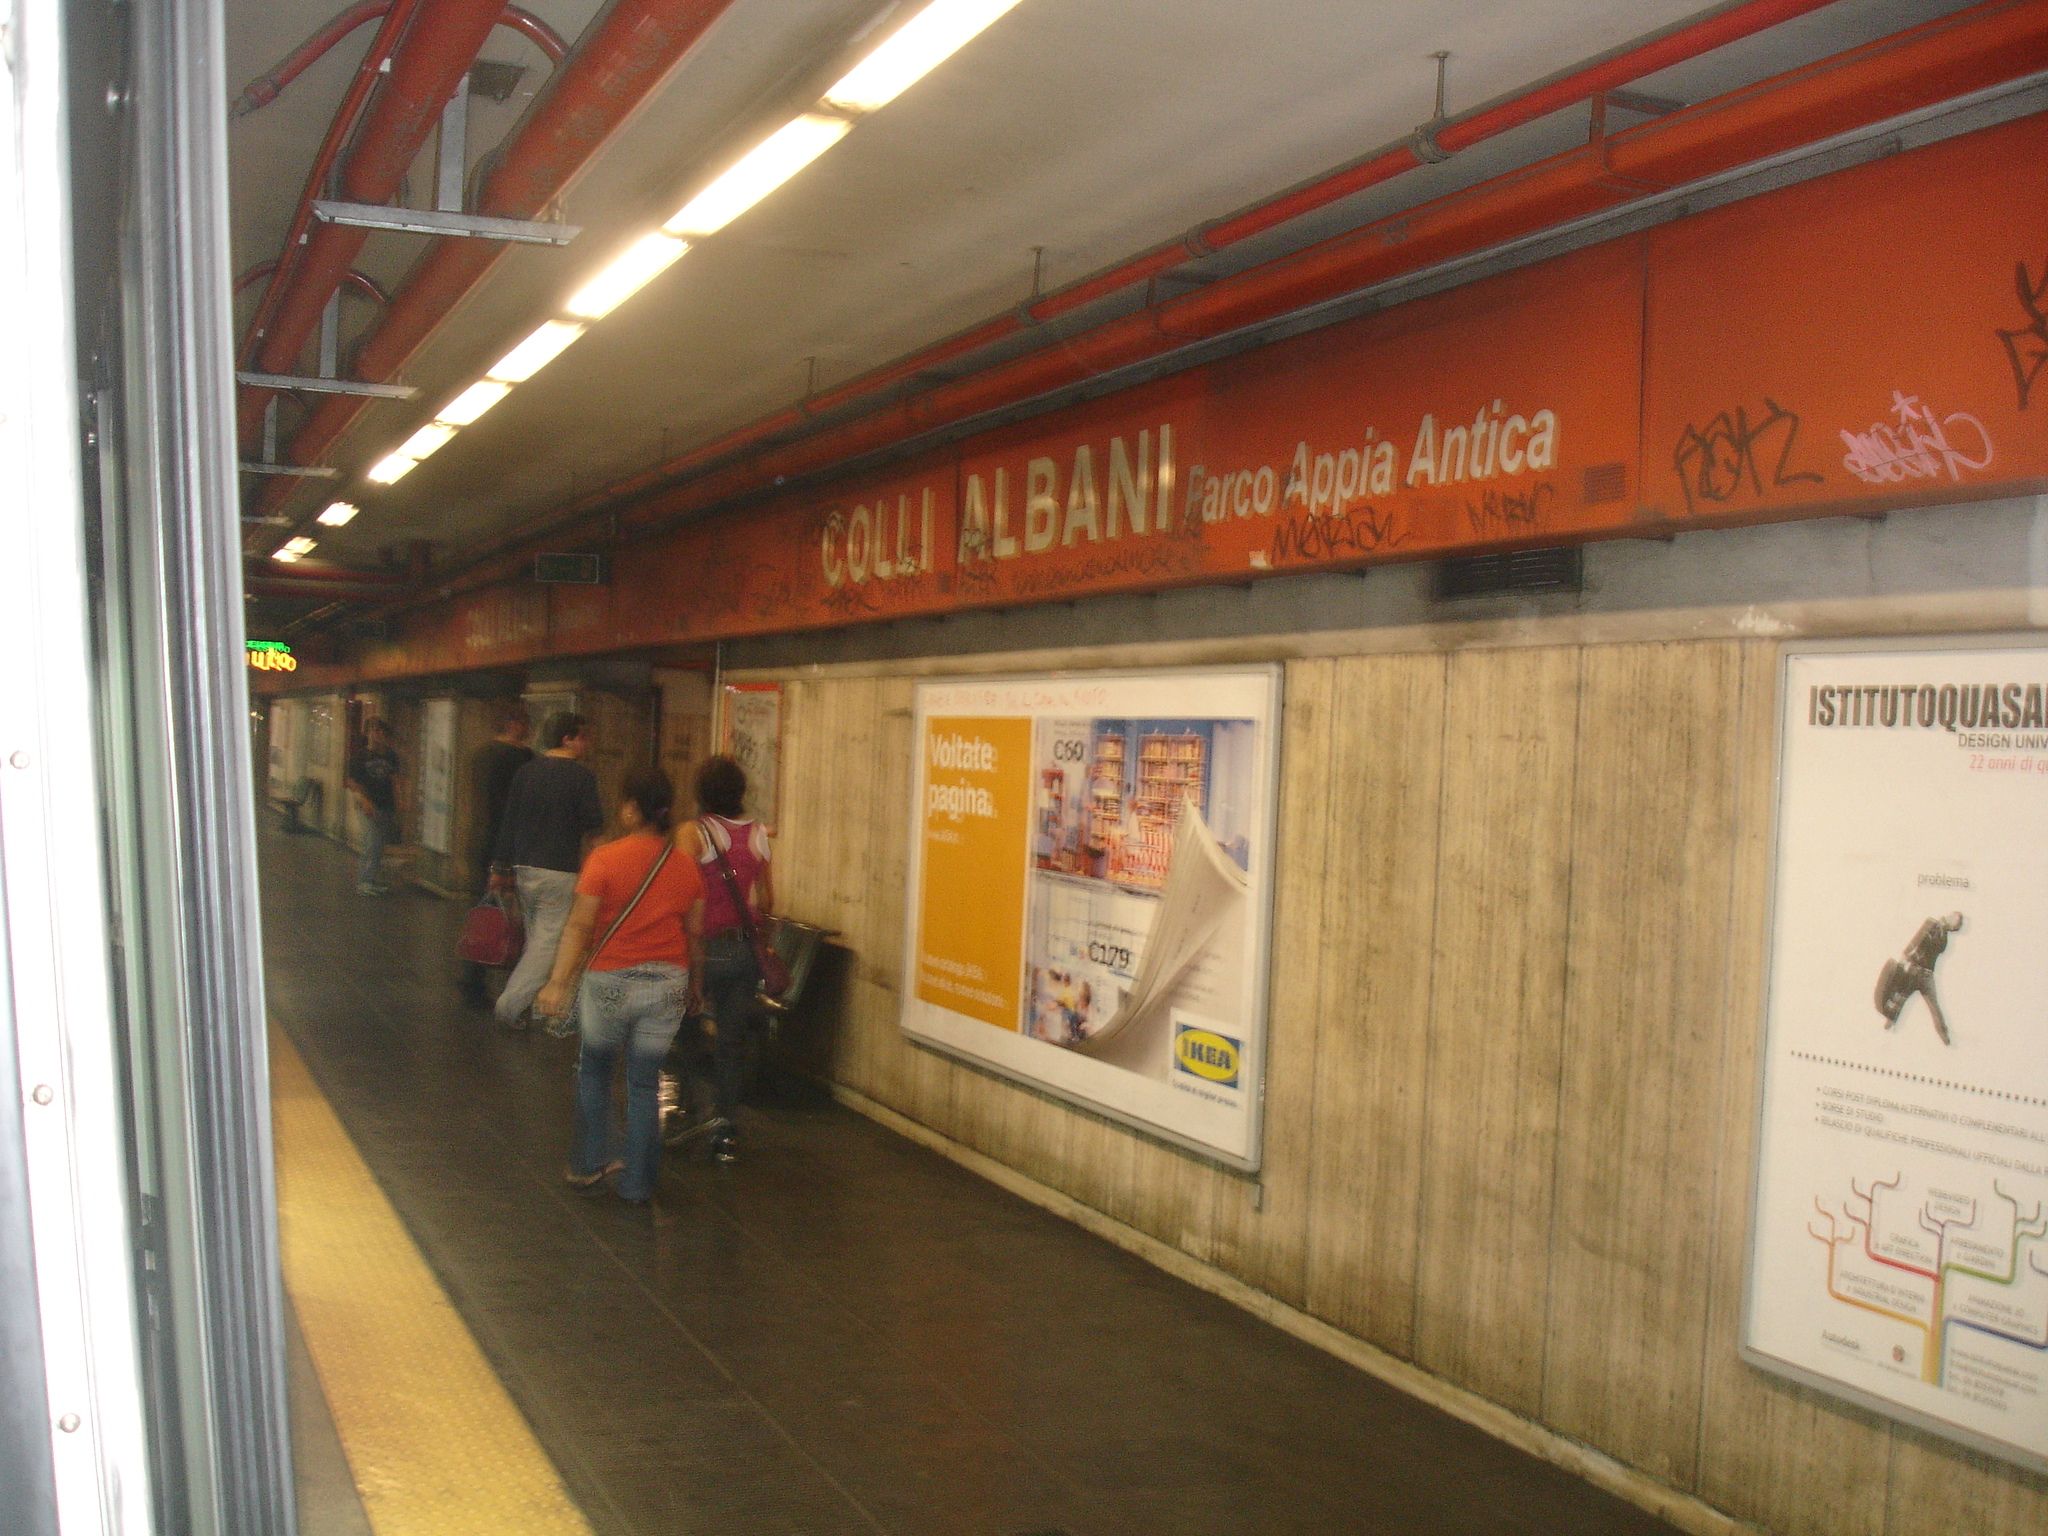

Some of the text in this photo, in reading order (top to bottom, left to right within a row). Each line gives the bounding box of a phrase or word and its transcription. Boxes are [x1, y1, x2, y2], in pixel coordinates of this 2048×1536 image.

[1284, 426, 1397, 521] Appia
[1406, 399, 1558, 486] Antica
[822, 487, 933, 587] COLLI
[957, 423, 1174, 564] ALBANI
[1808, 683, 2048, 732] ISTITUTOQUASA
[930, 733, 996, 772] Voltate
[1957, 733, 2011, 749] DESIGN
[1969, 753, 1985, 770] 22
[1987, 755, 2016, 770] anni
[2020, 754, 2033, 771] di
[1917, 872, 1969, 889] problema
[1182, 1036, 1232, 1070] IKEA
